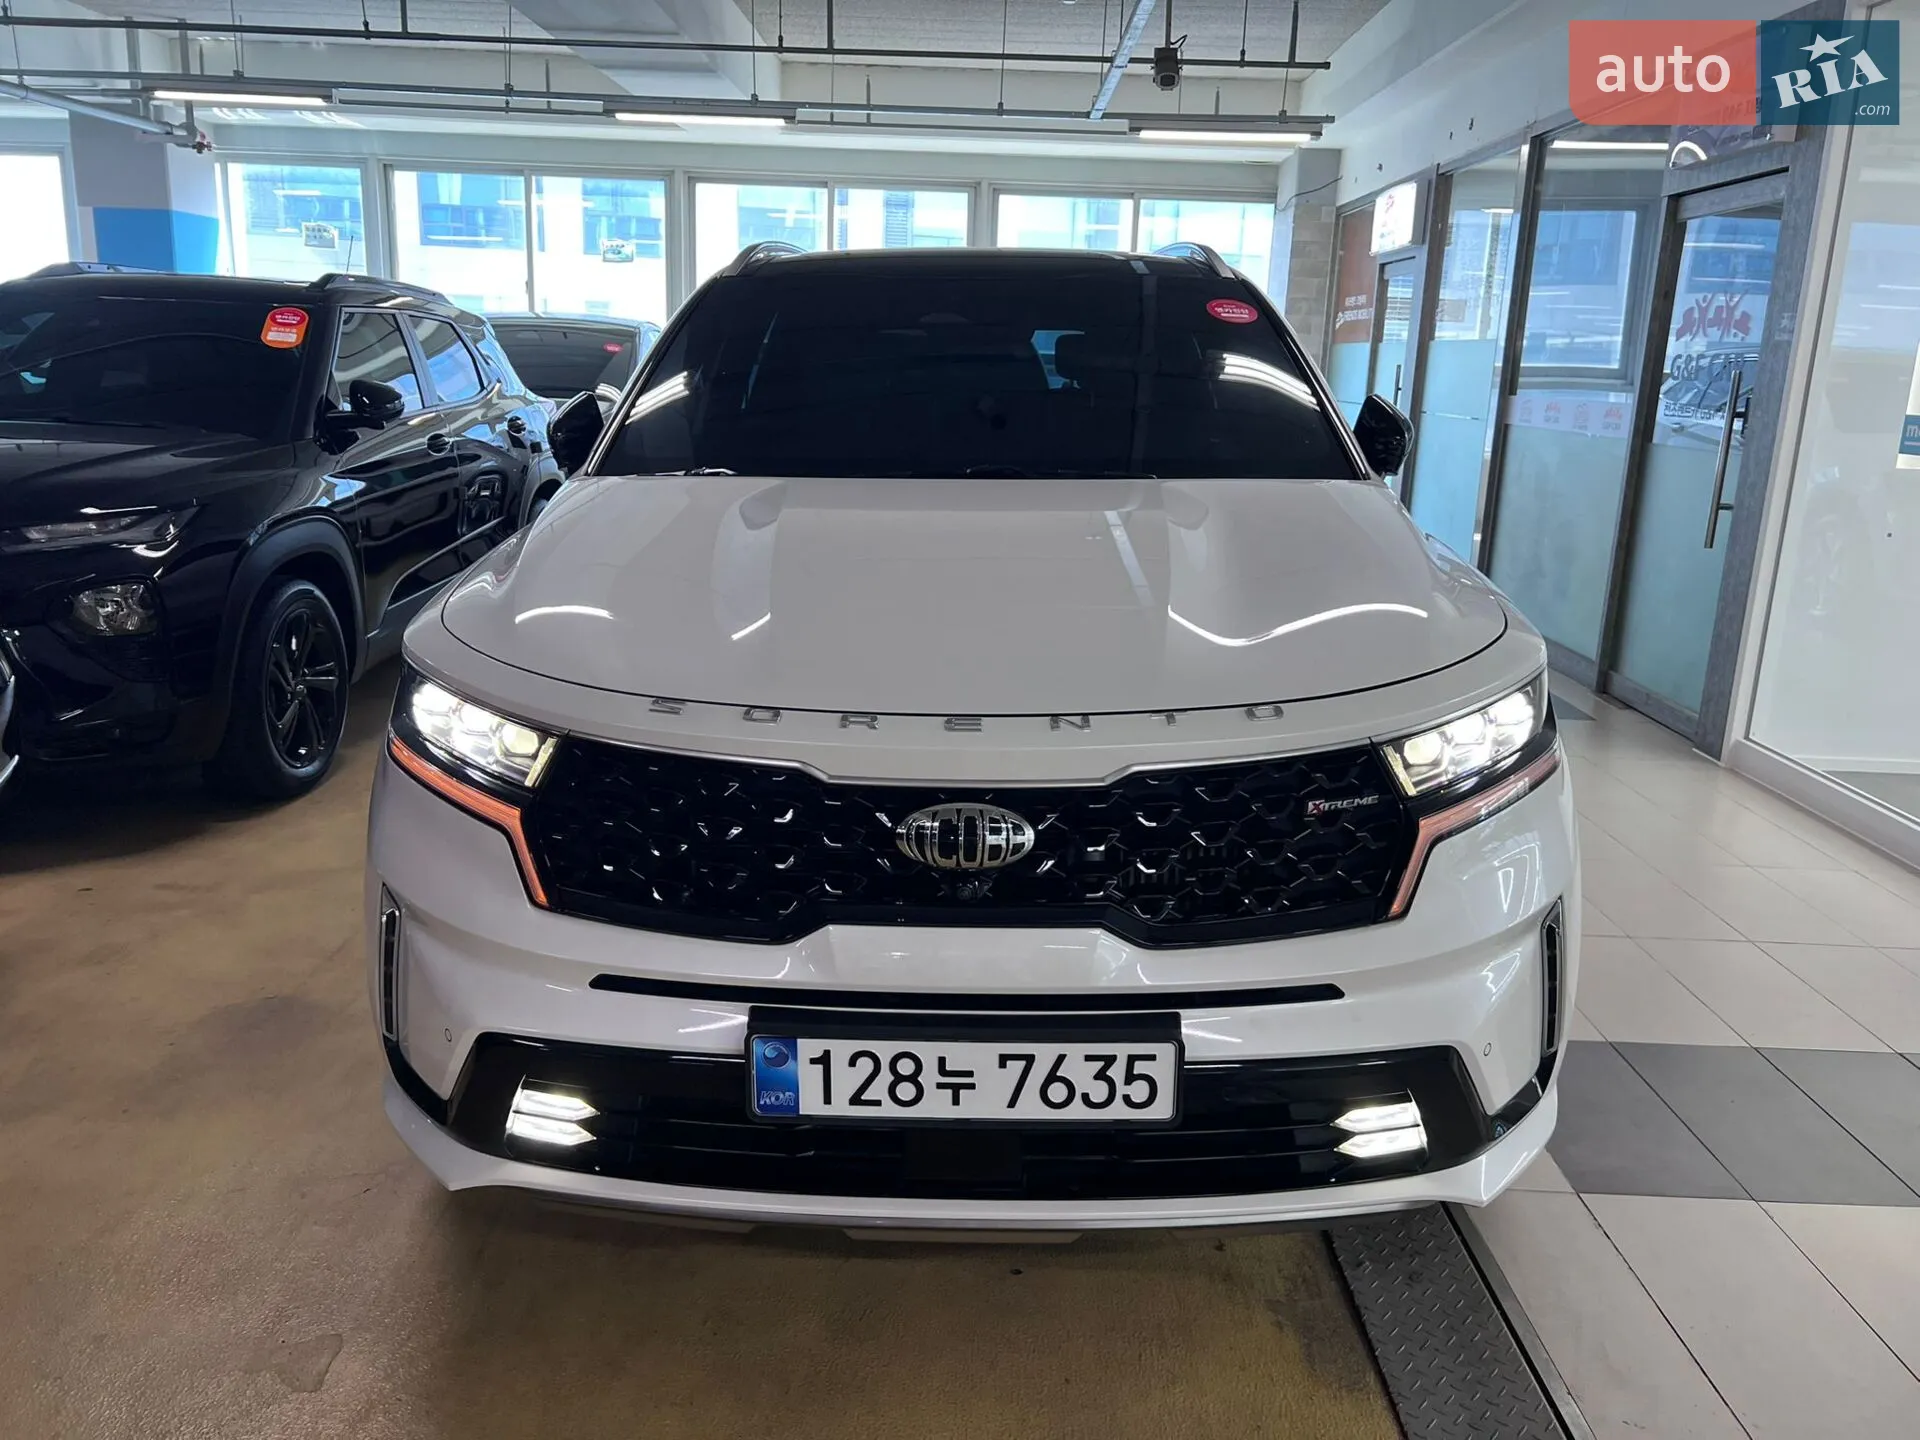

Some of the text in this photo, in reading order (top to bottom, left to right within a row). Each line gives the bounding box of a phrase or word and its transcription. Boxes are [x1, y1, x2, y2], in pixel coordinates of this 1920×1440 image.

[649, 698, 1284, 732] SORENTO
[1307, 795, 1380, 815] XTREME
[809, 1048, 1159, 1111] 128누 7635
[759, 1090, 795, 1106] KOR
